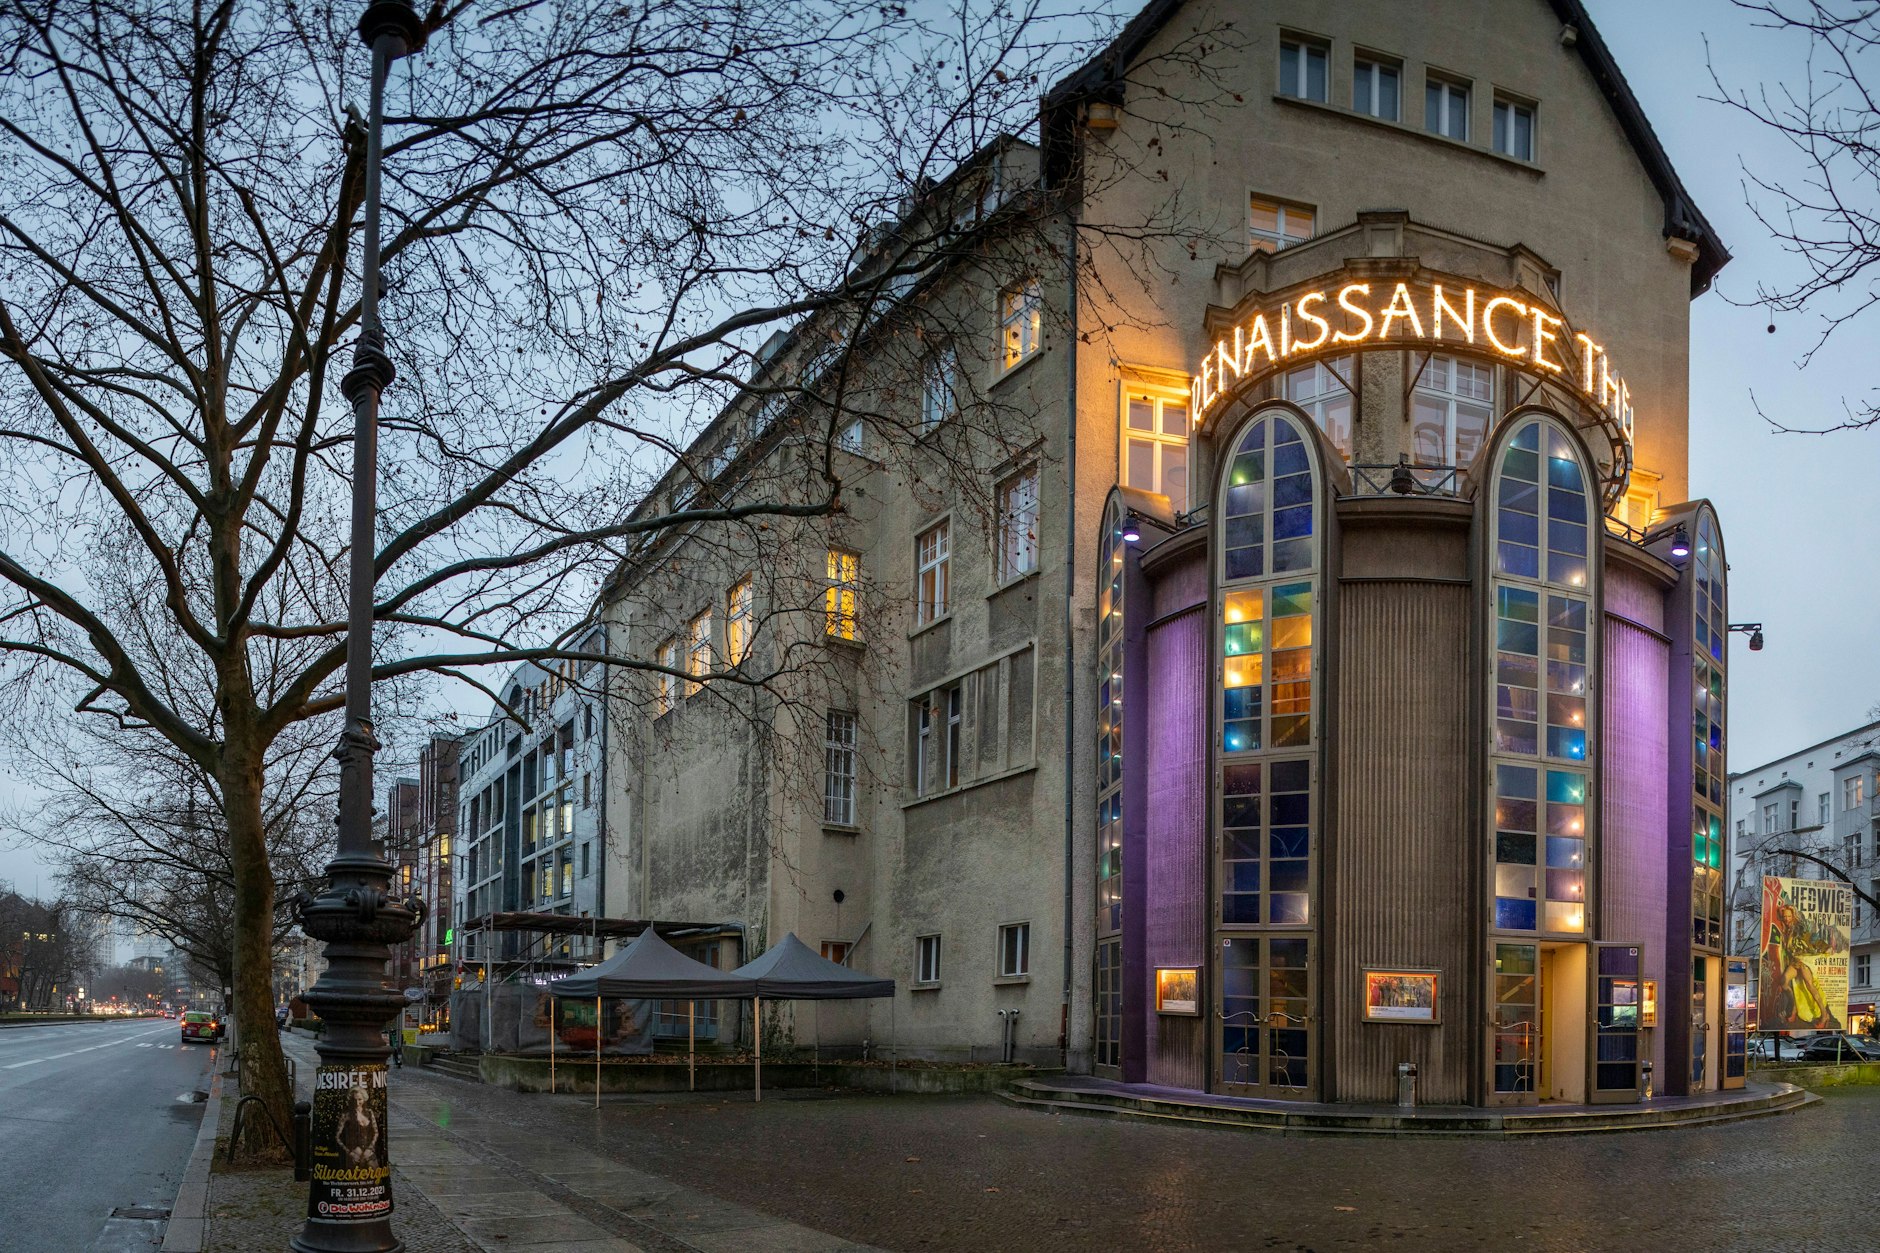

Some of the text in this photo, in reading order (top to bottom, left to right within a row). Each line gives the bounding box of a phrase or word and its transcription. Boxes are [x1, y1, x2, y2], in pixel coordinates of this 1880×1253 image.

[1191, 282, 1563, 431] RENAISSANCE
[1791, 886, 1845, 914] HEDWIG
[1808, 913, 1850, 927] ANGRY INCH
[1814, 957, 1828, 966] SVEN
[331, 1186, 385, 1197] FR. 31.12.2021
